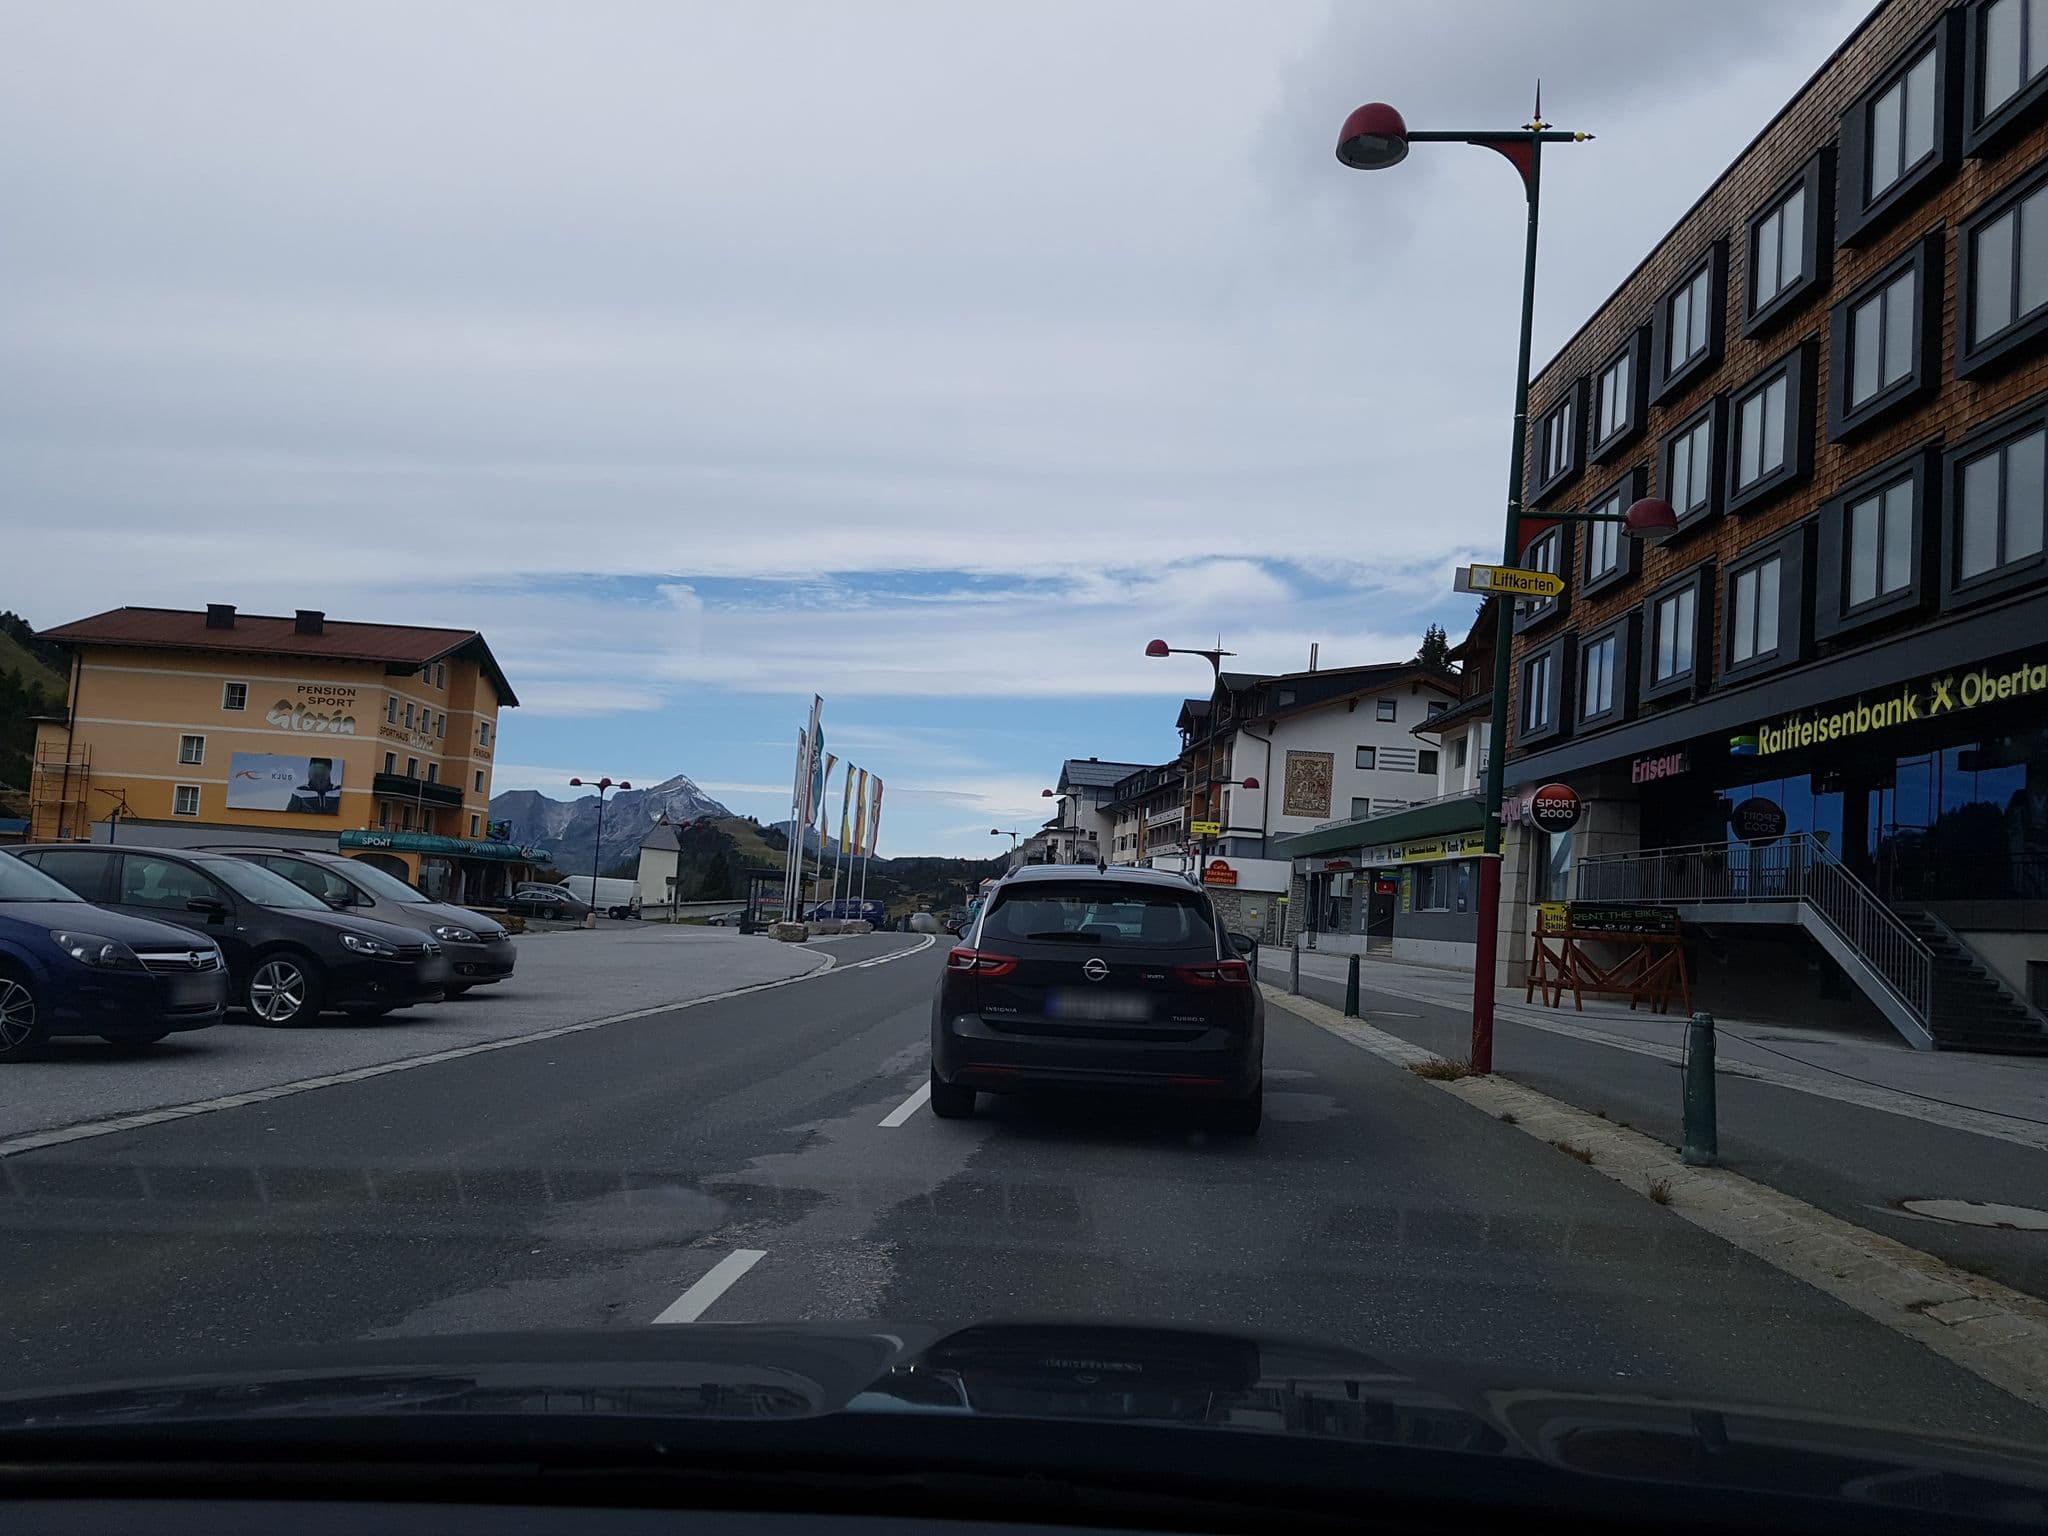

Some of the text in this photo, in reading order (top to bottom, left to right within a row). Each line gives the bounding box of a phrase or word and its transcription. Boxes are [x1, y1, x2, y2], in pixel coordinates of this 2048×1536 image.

[1493, 571, 1554, 592] Liftkarten
[297, 685, 356, 696] PENSION
[307, 696, 355, 707] SPORT
[1757, 662, 2048, 756] Raiffeisenbank Oberta
[379, 726, 408, 742] SPORTHAUS
[1631, 752, 1681, 784] Friseur
[271, 773, 294, 781] KJUS
[1536, 799, 1577, 809] SPORT
[1539, 809, 1574, 819] 2000
[361, 837, 392, 847] SPORT
[1572, 912, 1606, 921] RENT
[1606, 910, 1633, 919] THE
[1634, 908, 1661, 918] BIKE
